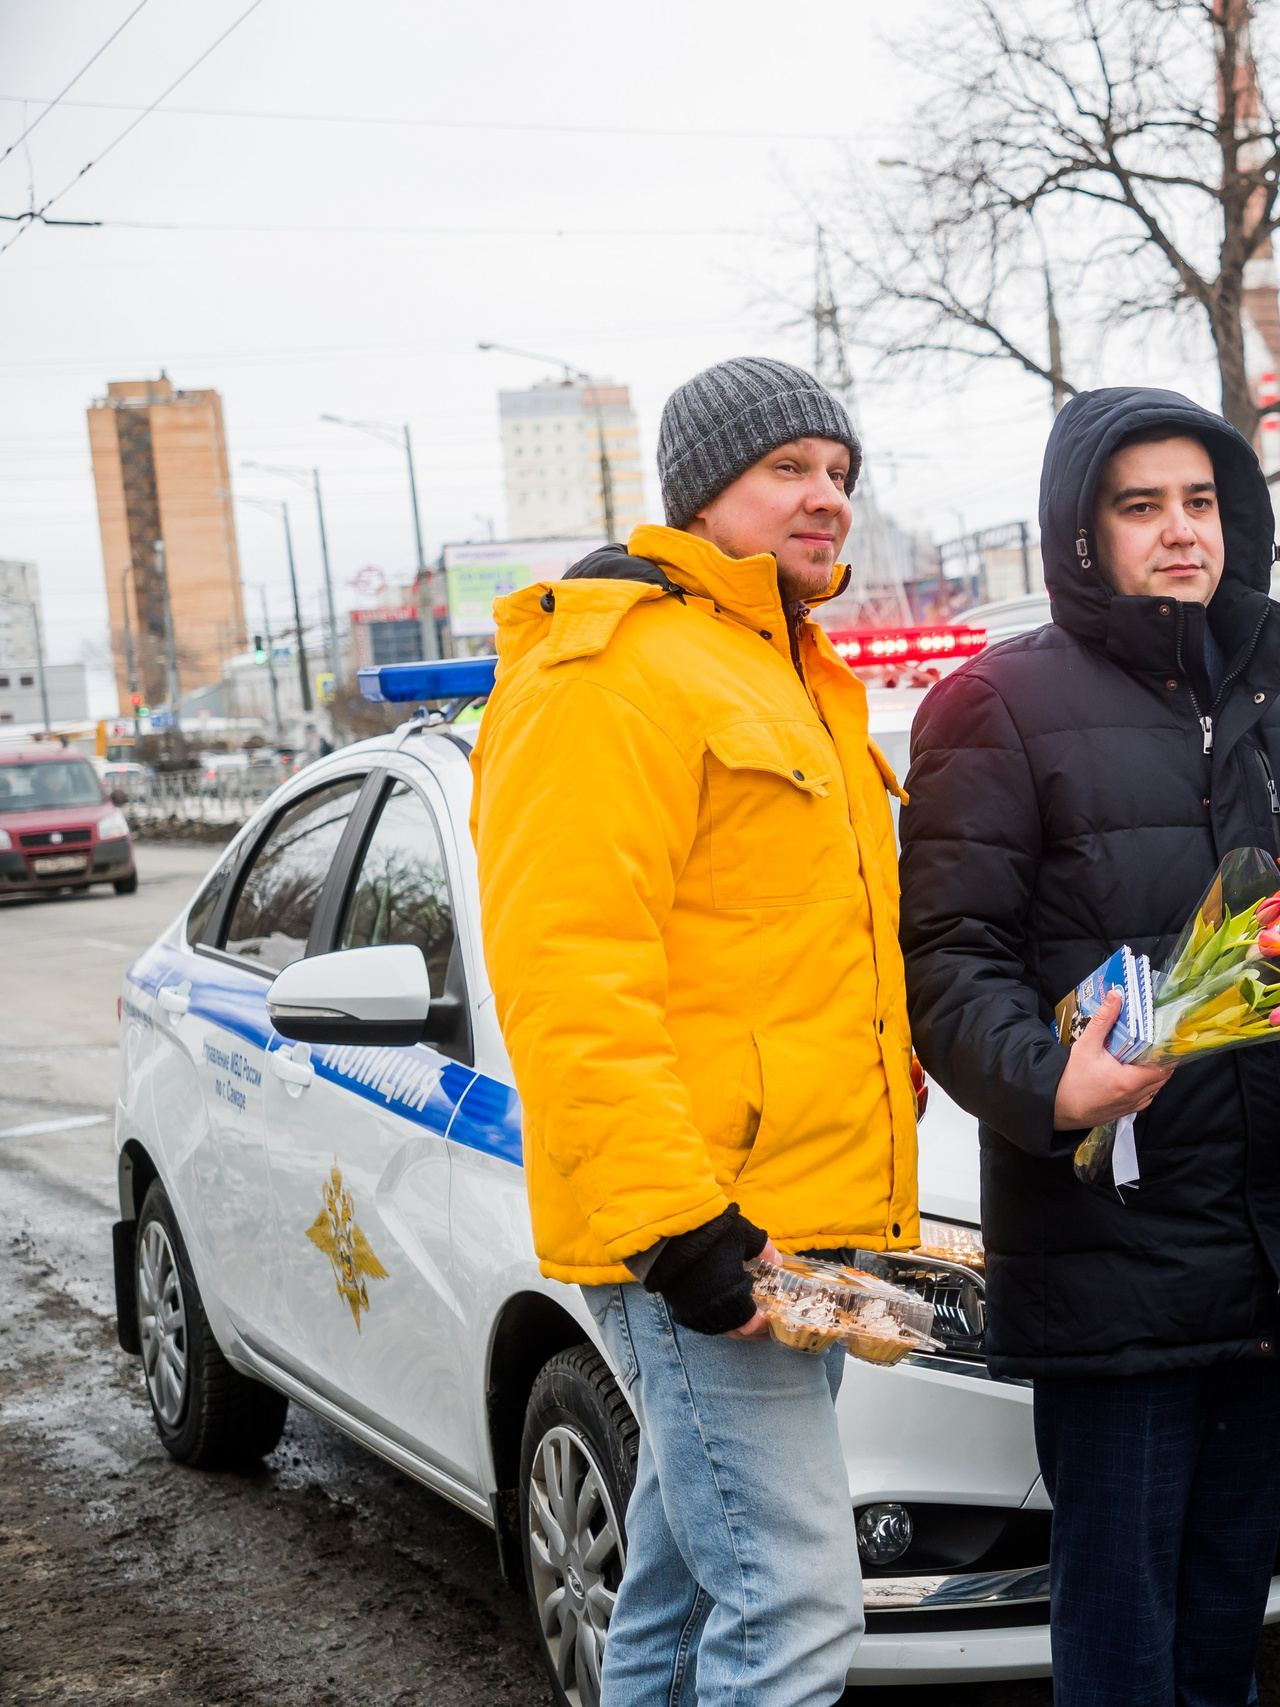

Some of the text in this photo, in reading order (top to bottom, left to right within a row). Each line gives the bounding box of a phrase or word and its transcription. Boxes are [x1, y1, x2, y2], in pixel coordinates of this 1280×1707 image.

[230, 1051, 243, 1081] МВД
[243, 1057, 262, 1087] России
[321, 1044, 446, 1113] ПОЛИЦИЯ
